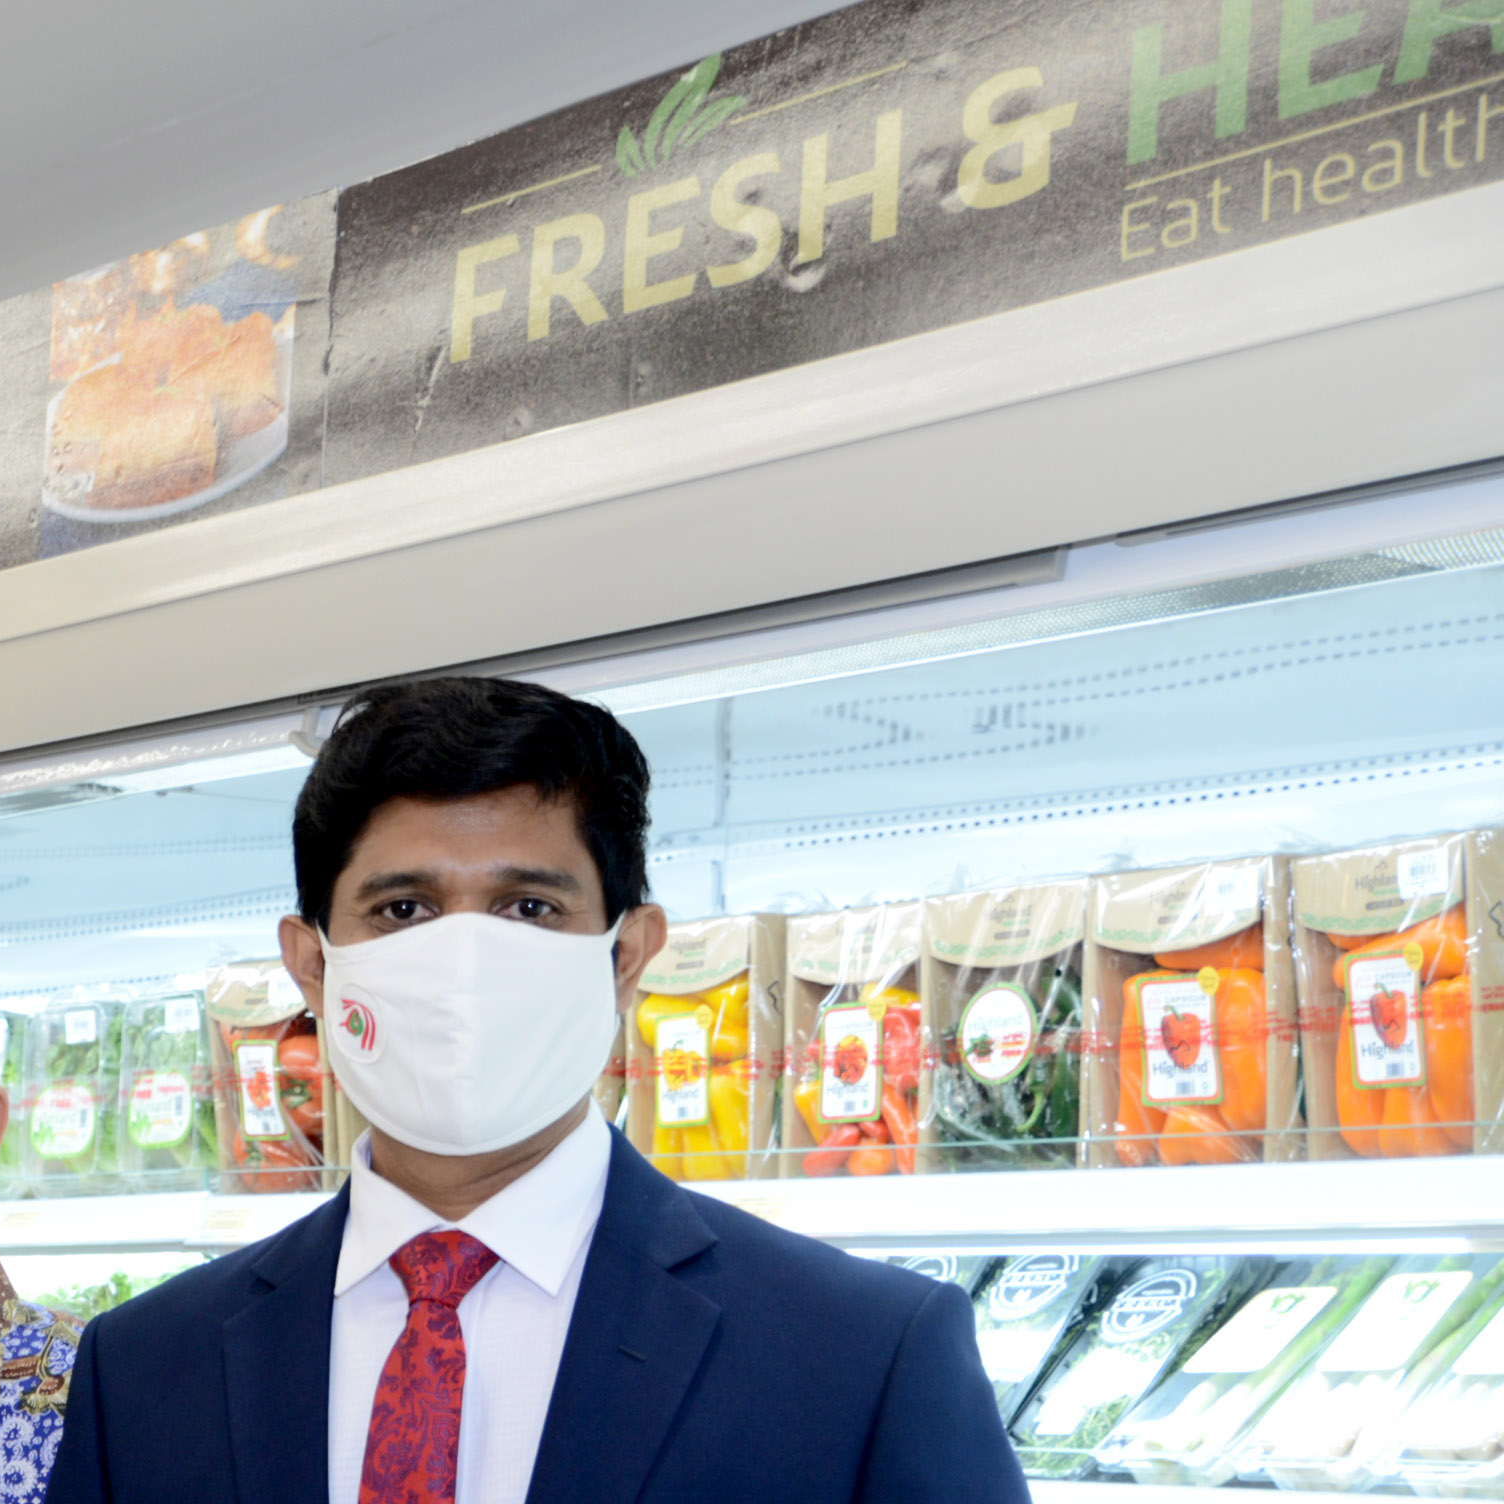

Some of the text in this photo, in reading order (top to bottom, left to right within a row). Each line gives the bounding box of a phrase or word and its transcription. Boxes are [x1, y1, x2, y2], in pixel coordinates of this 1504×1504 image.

[448, 107, 903, 363] FRESH
[957, 66, 1078, 210] &
[1121, 178, 1234, 262] Eat
[1355, 873, 1397, 893] Highlan
[1361, 1040, 1414, 1060] Highland
[1153, 1060, 1208, 1078] Highland
